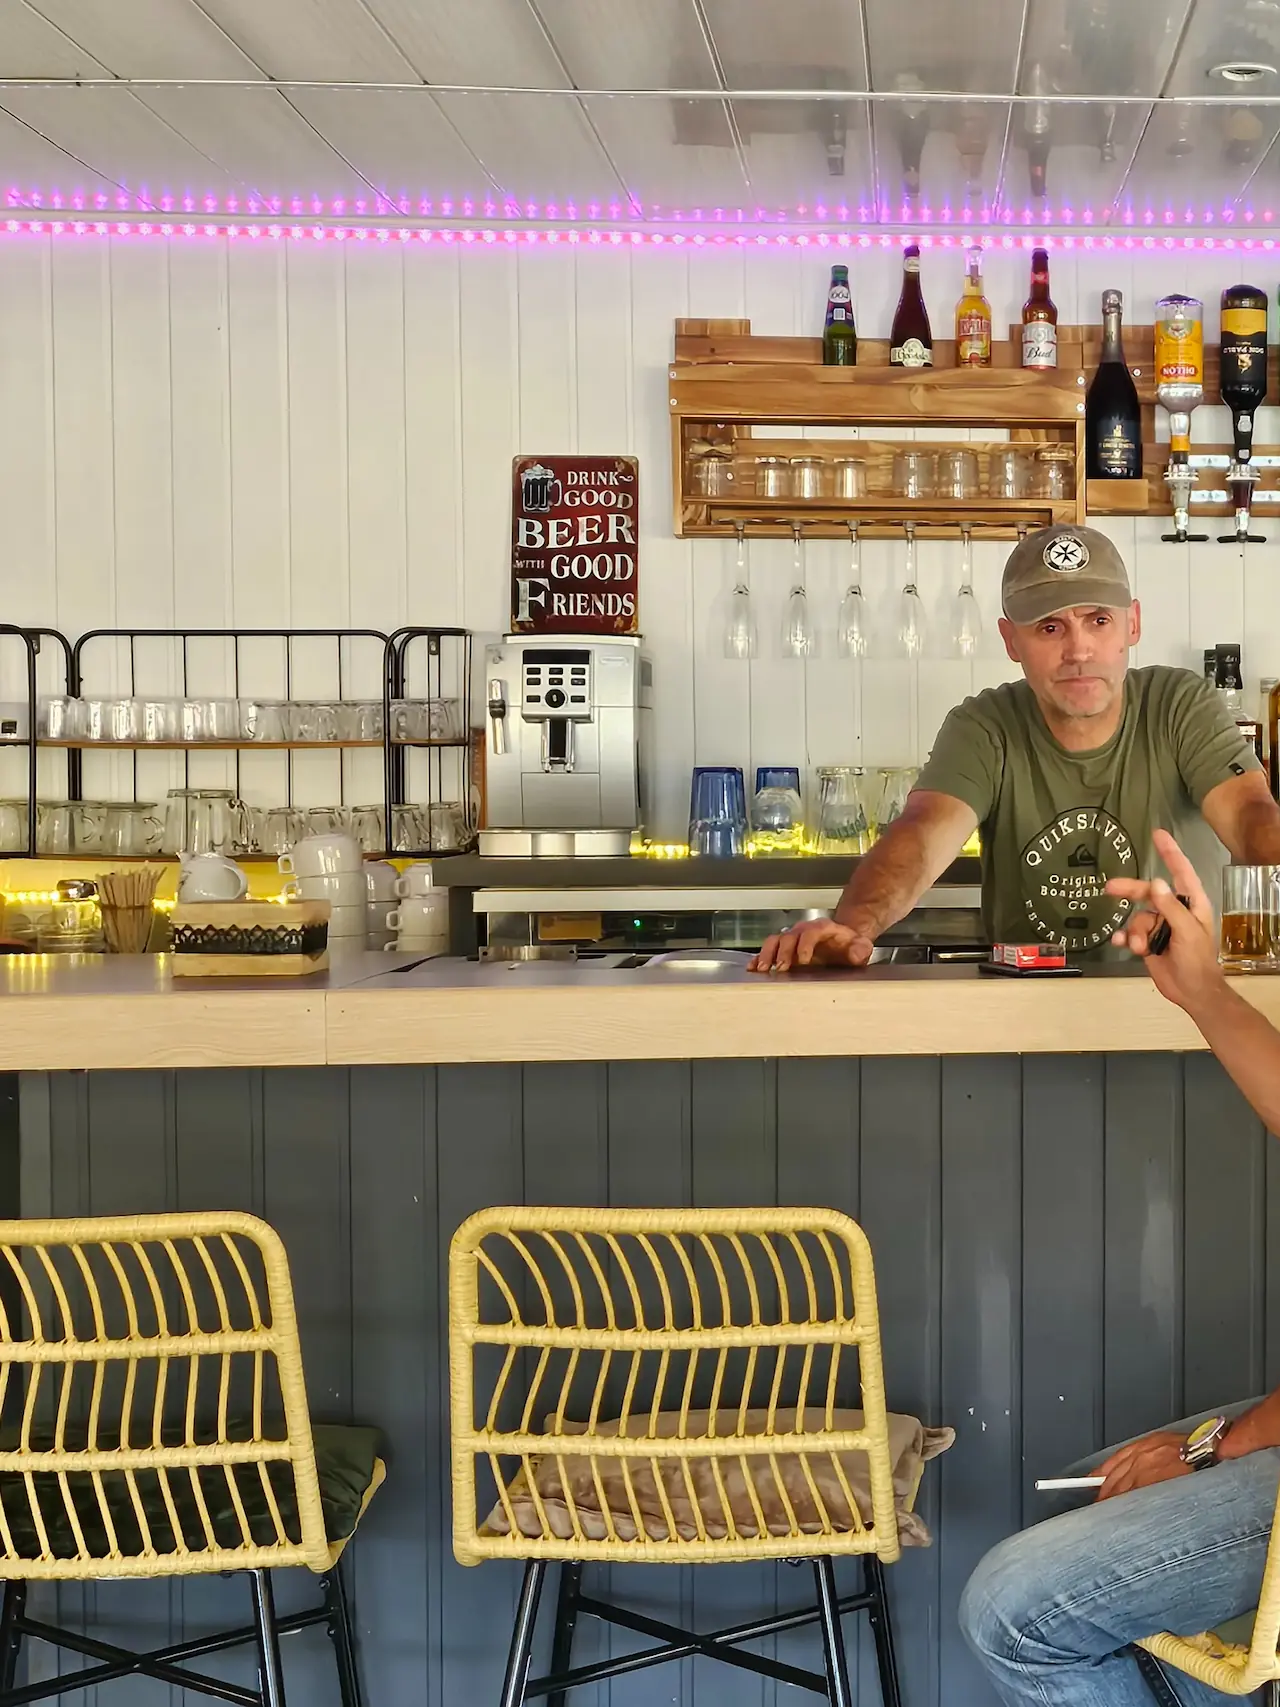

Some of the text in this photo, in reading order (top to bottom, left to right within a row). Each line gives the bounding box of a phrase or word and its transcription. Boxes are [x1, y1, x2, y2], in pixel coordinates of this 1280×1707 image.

[1027, 346, 1053, 359] Bud
[1162, 367, 1196, 376] DILLON
[564, 489, 634, 509] GOOD
[516, 513, 636, 549] BEER
[514, 553, 634, 581] WITH GOOD
[515, 577, 636, 622] FRIENDS
[1049, 872, 1108, 888] Originl
[1067, 900, 1088, 910] Co
